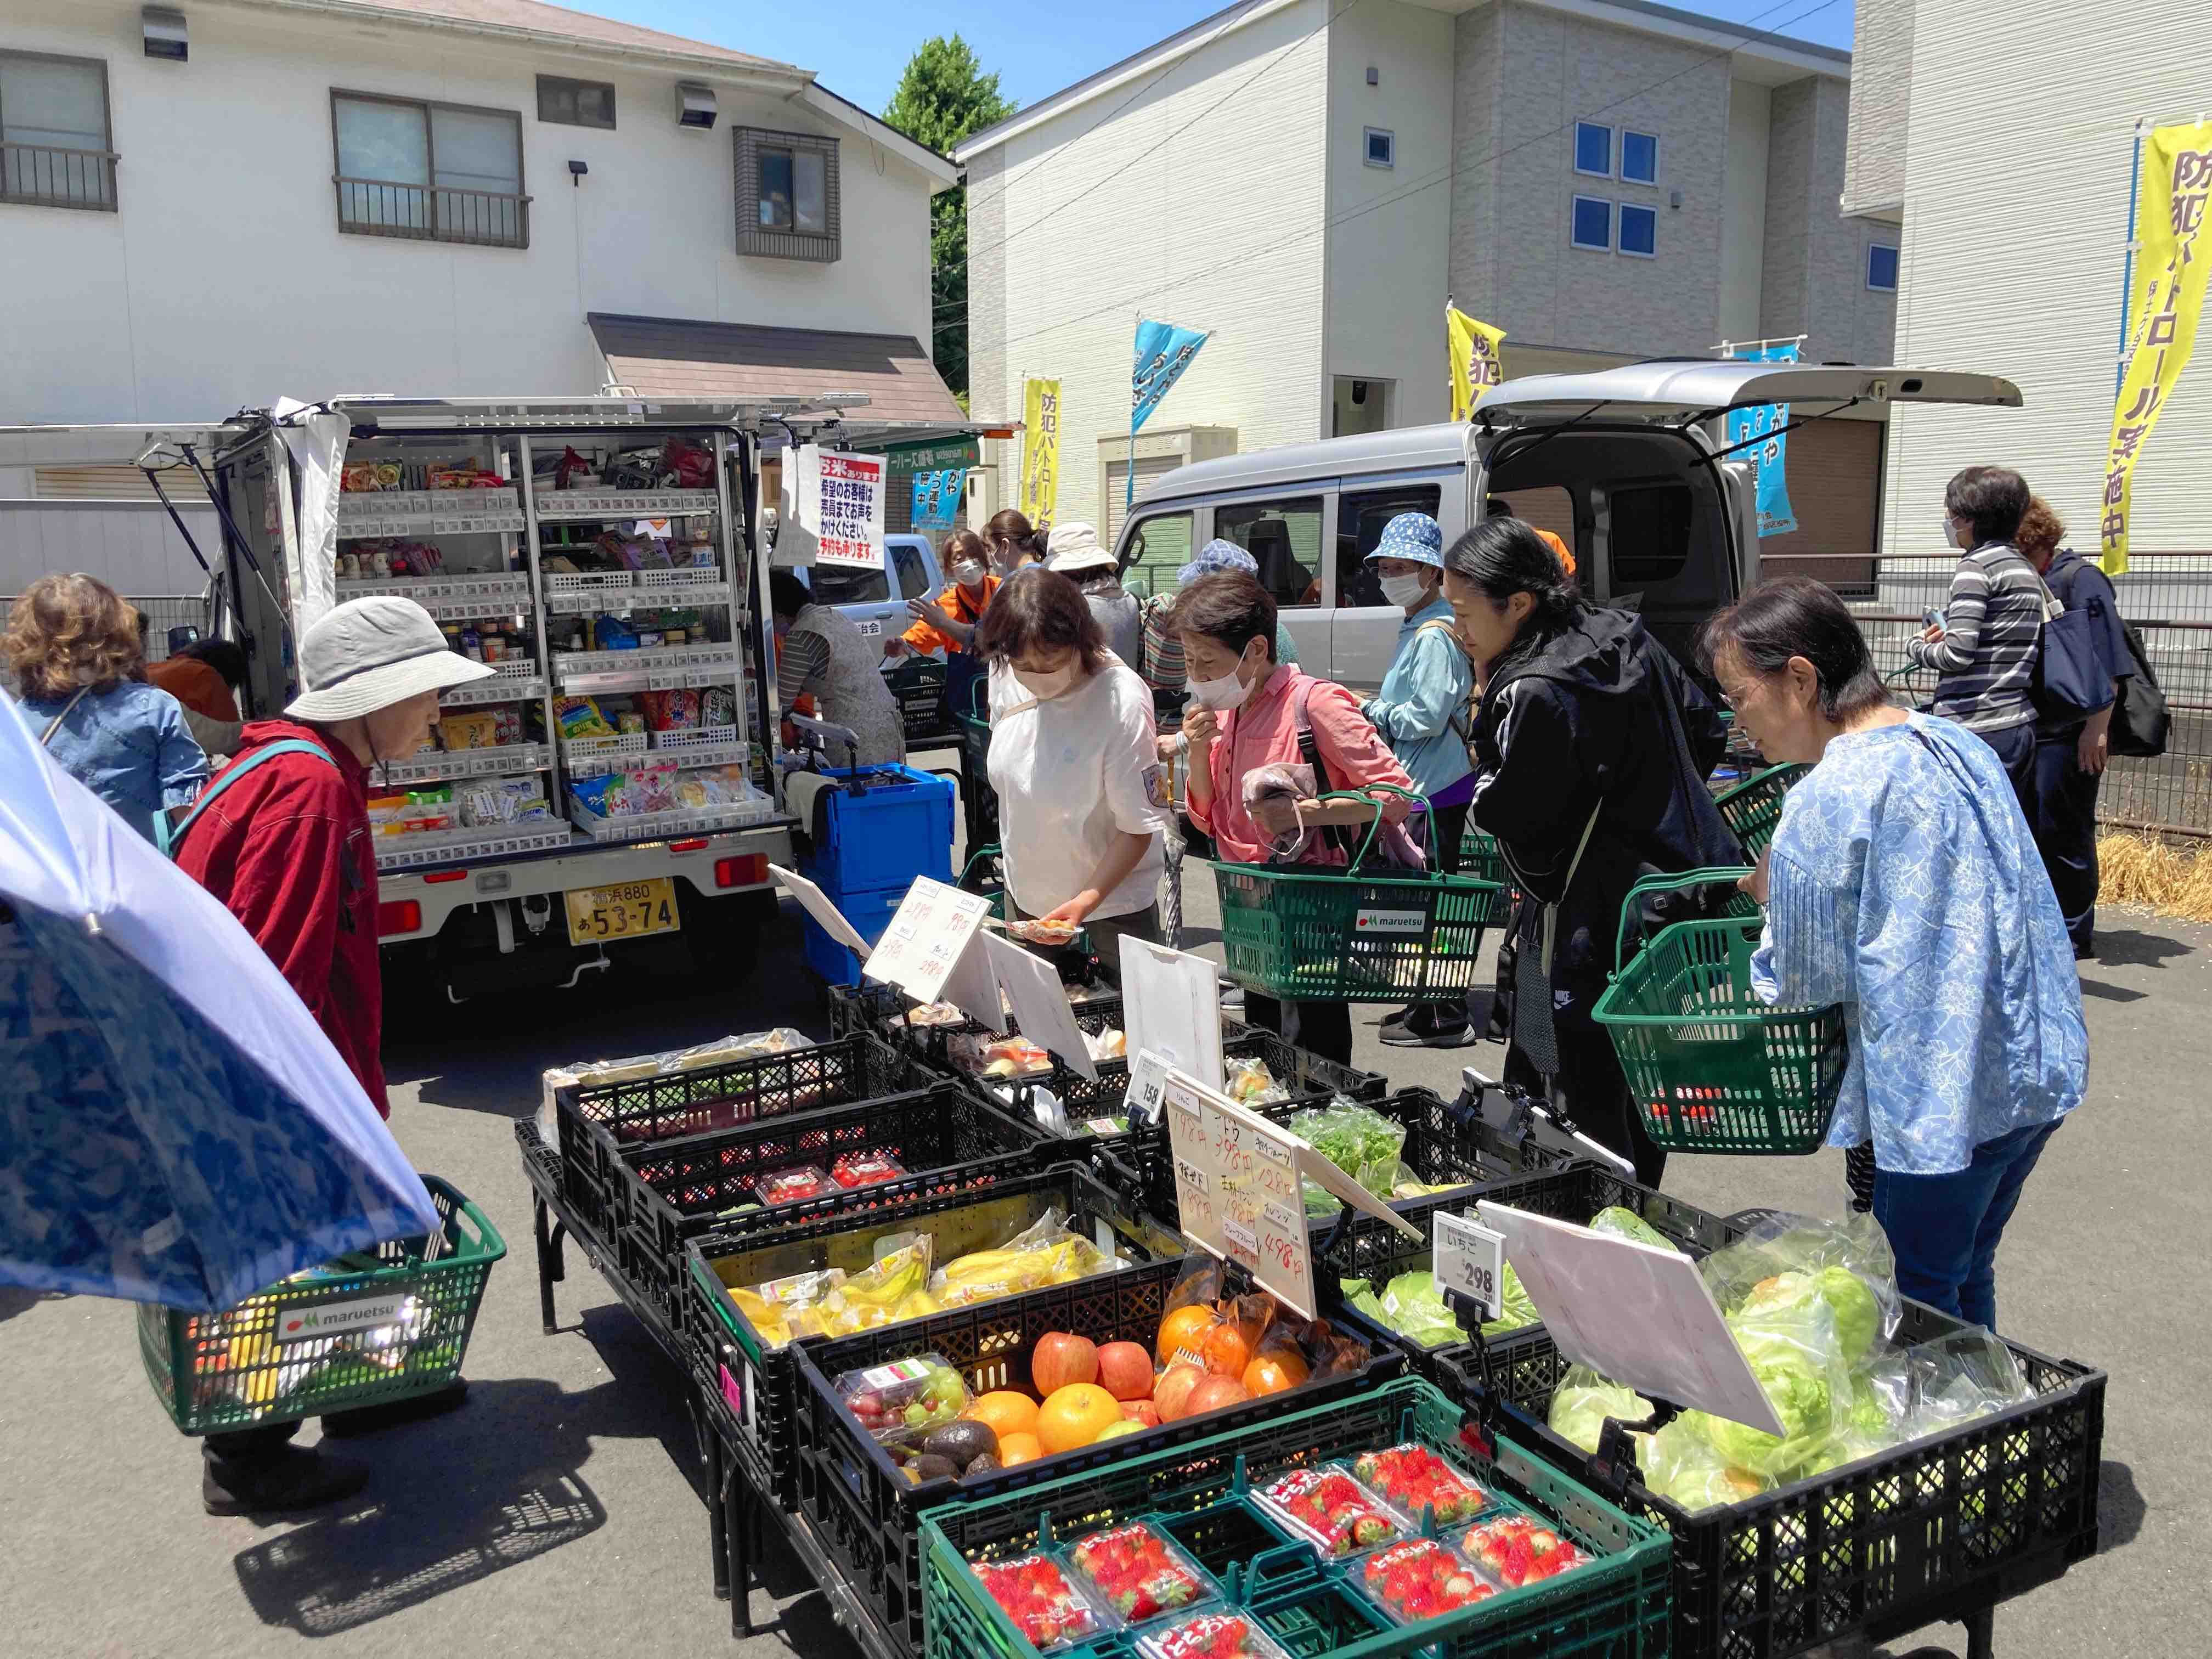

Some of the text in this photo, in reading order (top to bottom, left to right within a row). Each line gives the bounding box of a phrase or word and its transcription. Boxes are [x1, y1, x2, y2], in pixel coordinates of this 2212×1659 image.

[817, 537, 875, 560] 予約も承ります。
[592, 885, 650, 904] 横浜 880
[578, 899, 672, 935] あ 53-74
[1143, 1083, 1159, 1105] 158
[1173, 1113, 1207, 1150] 198円
[1215, 1135, 1254, 1183] 398円
[1265, 1233, 1304, 1283] 498円
[1465, 1263, 1492, 1293] 298
[323, 1304, 394, 1325] maruetsu
